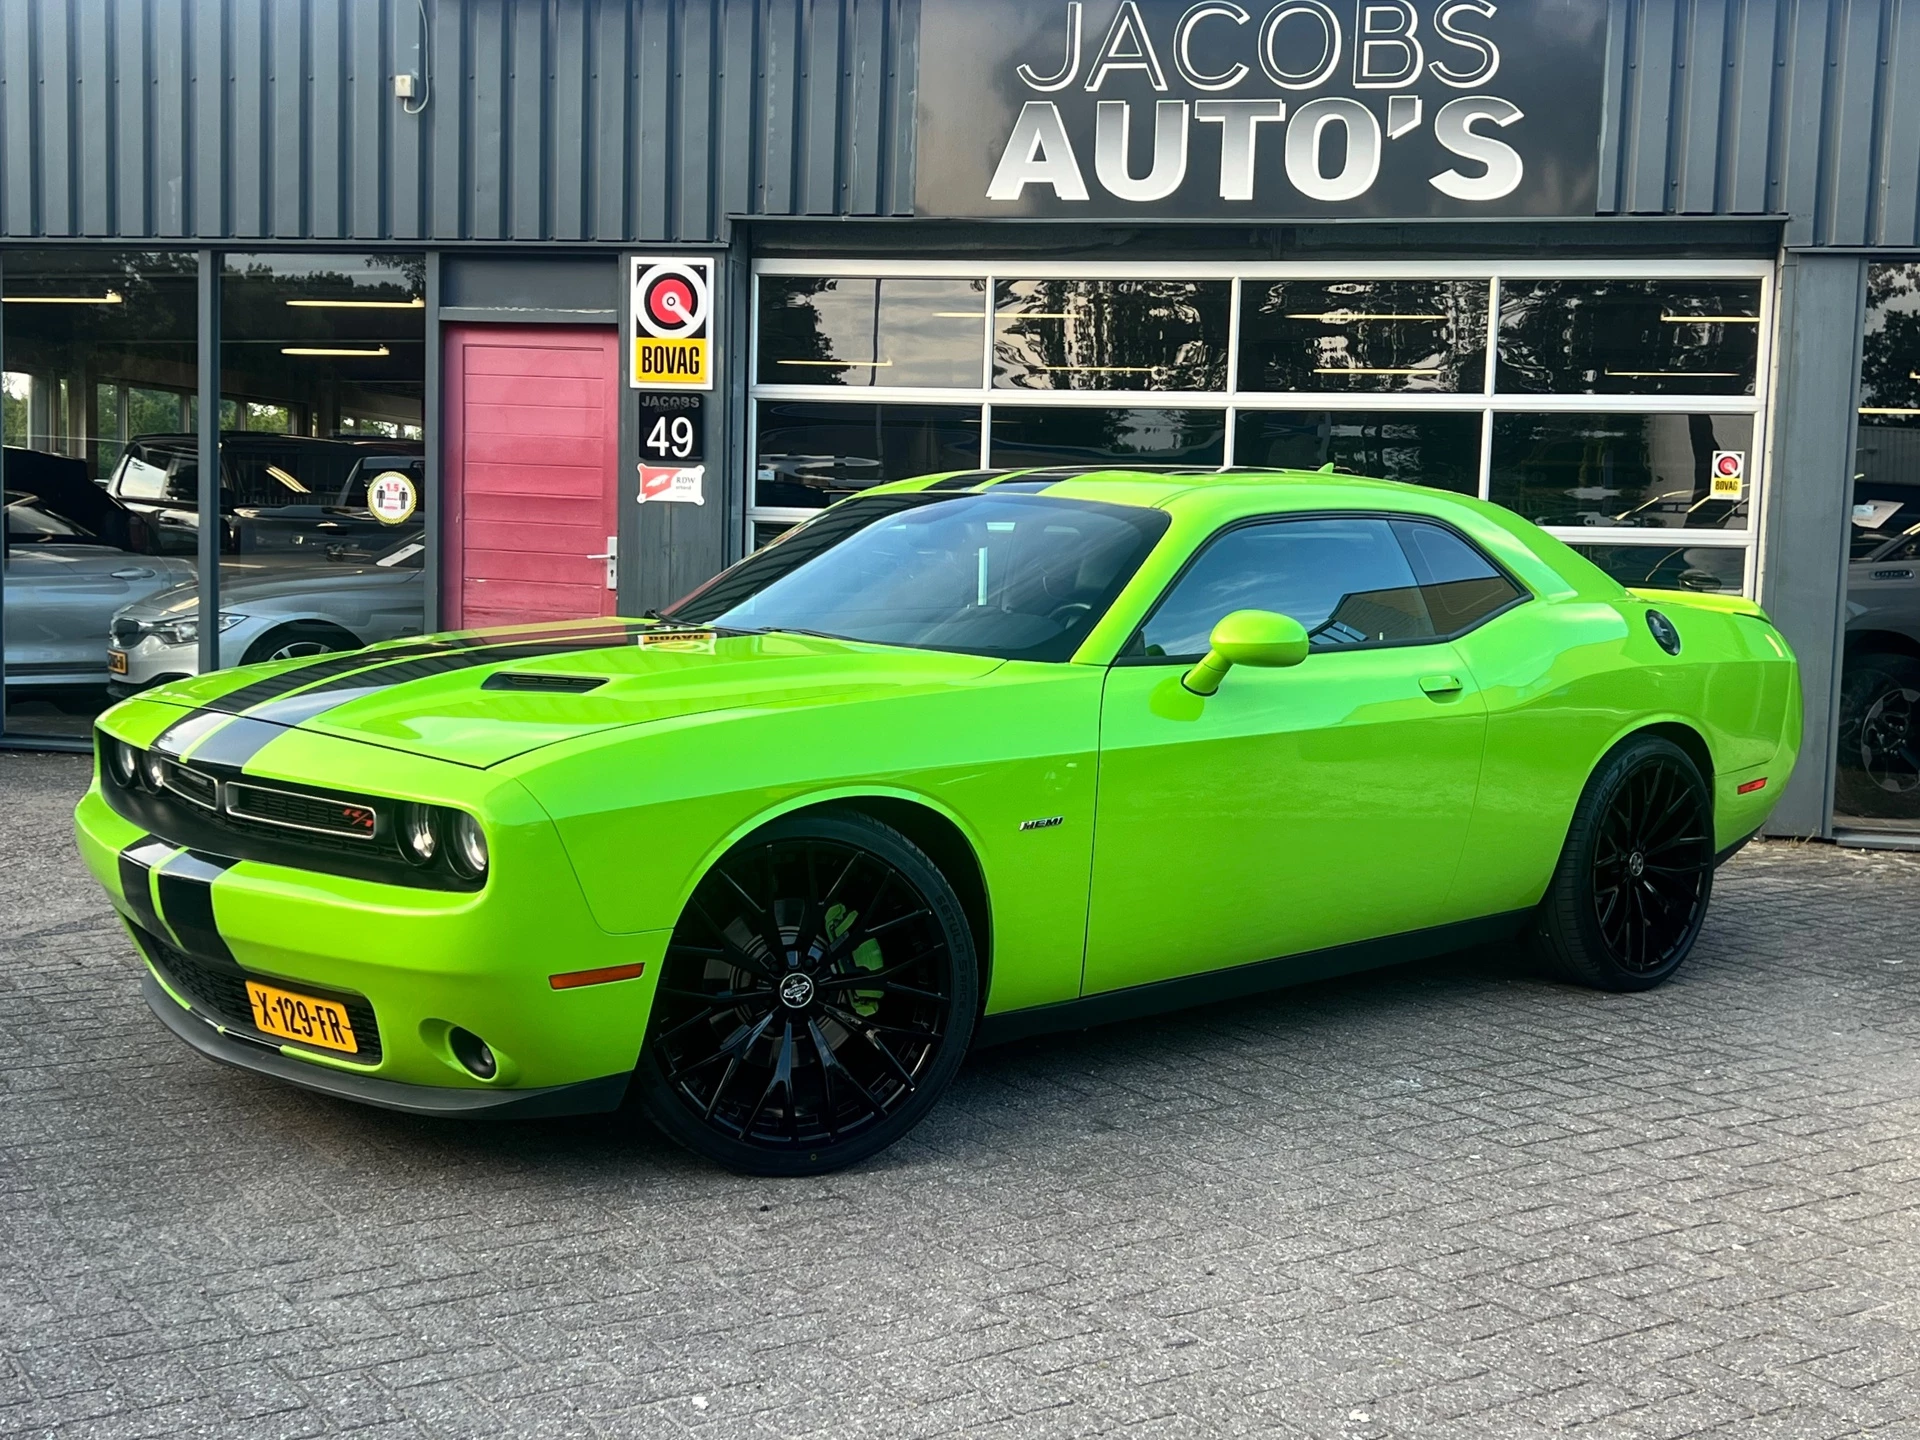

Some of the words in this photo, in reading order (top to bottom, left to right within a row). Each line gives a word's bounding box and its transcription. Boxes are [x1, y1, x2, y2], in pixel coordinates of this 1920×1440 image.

[1016, 0, 1500, 92] JACOBS
[985, 95, 1525, 201] AUTO'S
[641, 345, 700, 375] BOVAG
[641, 395, 700, 408] JACOBS
[646, 415, 694, 458] 49
[386, 483, 399, 492] 1.5
[676, 476, 696, 484] RDW
[1715, 480, 1738, 491] BOVAG
[342, 808, 374, 827] R/T
[1019, 815, 1064, 831] HEMI
[255, 991, 346, 1045] X-129-FR
